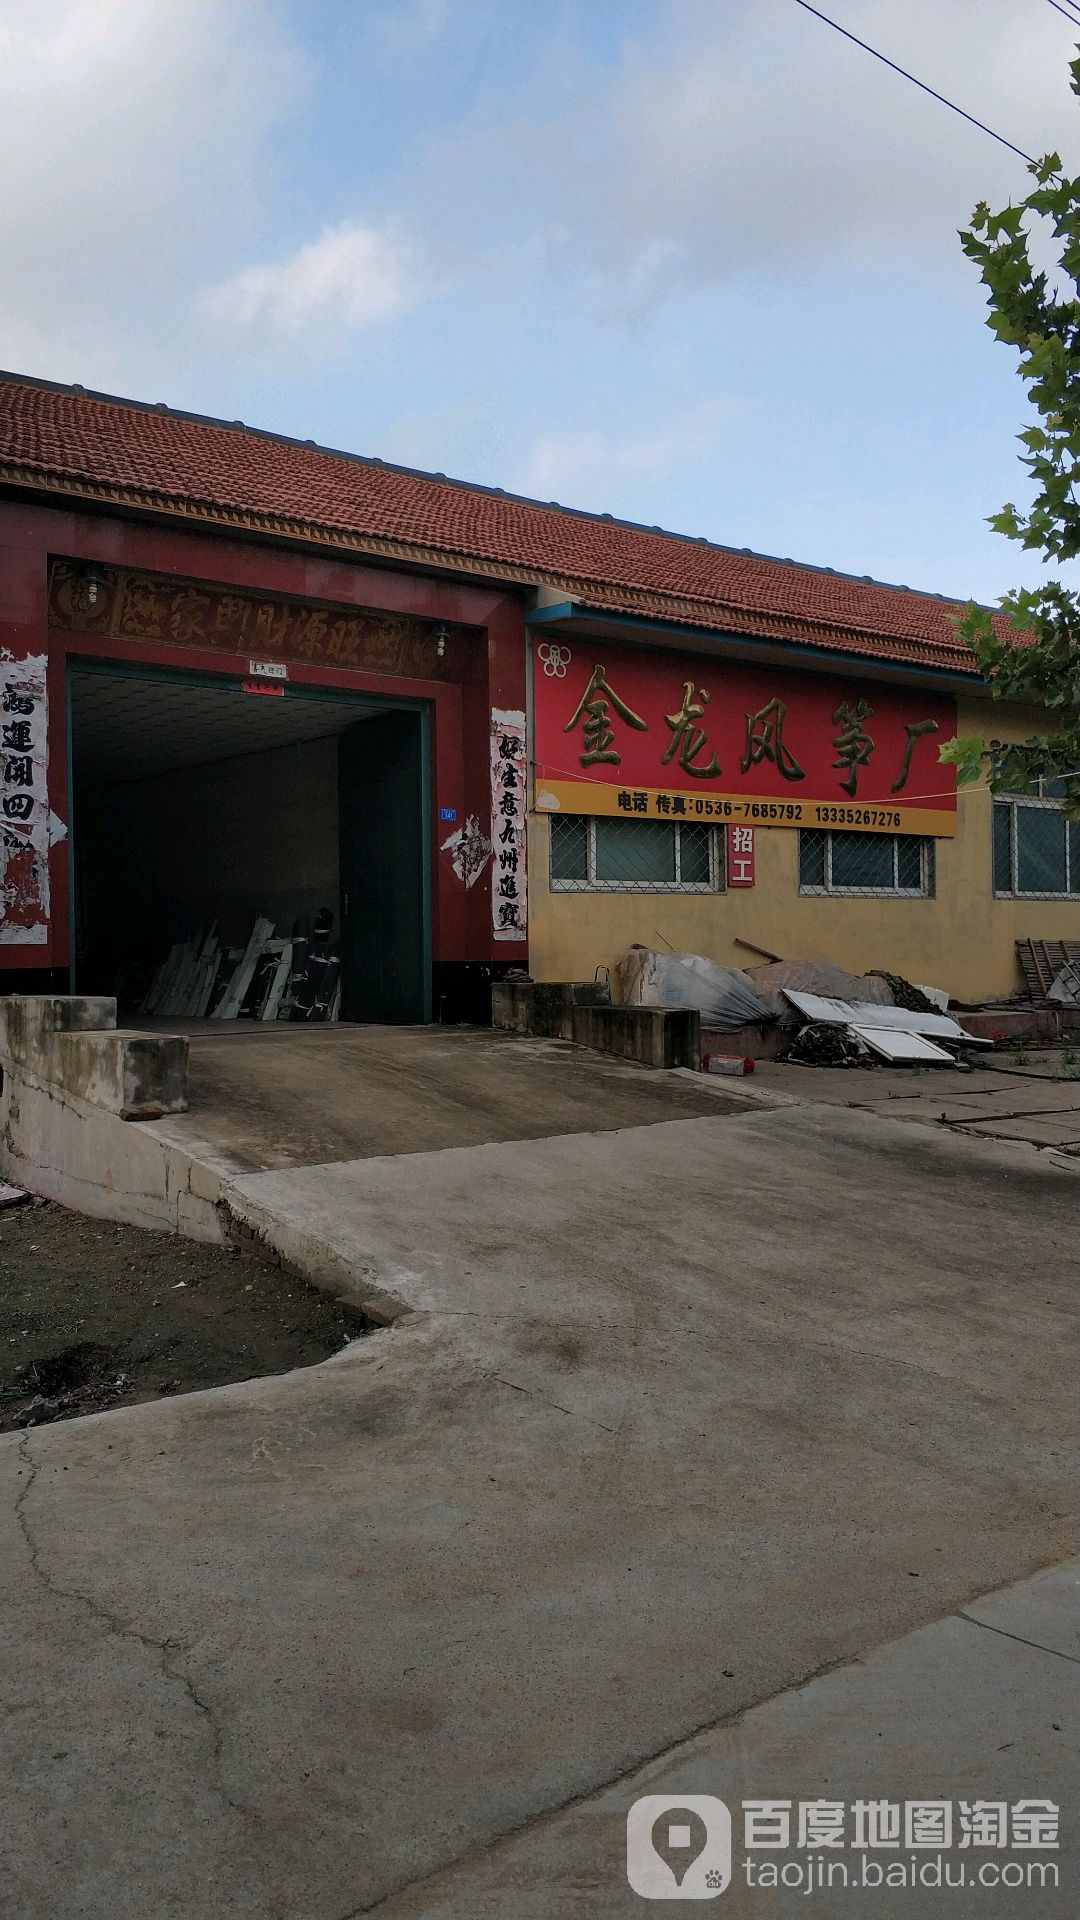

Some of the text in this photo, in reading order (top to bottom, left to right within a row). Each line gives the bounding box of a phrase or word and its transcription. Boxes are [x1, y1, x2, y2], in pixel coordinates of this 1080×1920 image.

[563, 664, 940, 797] 金龙风筝厂
[617, 790, 648, 812] 电话
[815, 806, 901, 827] 13335267276
[732, 827, 753, 882] 招工
